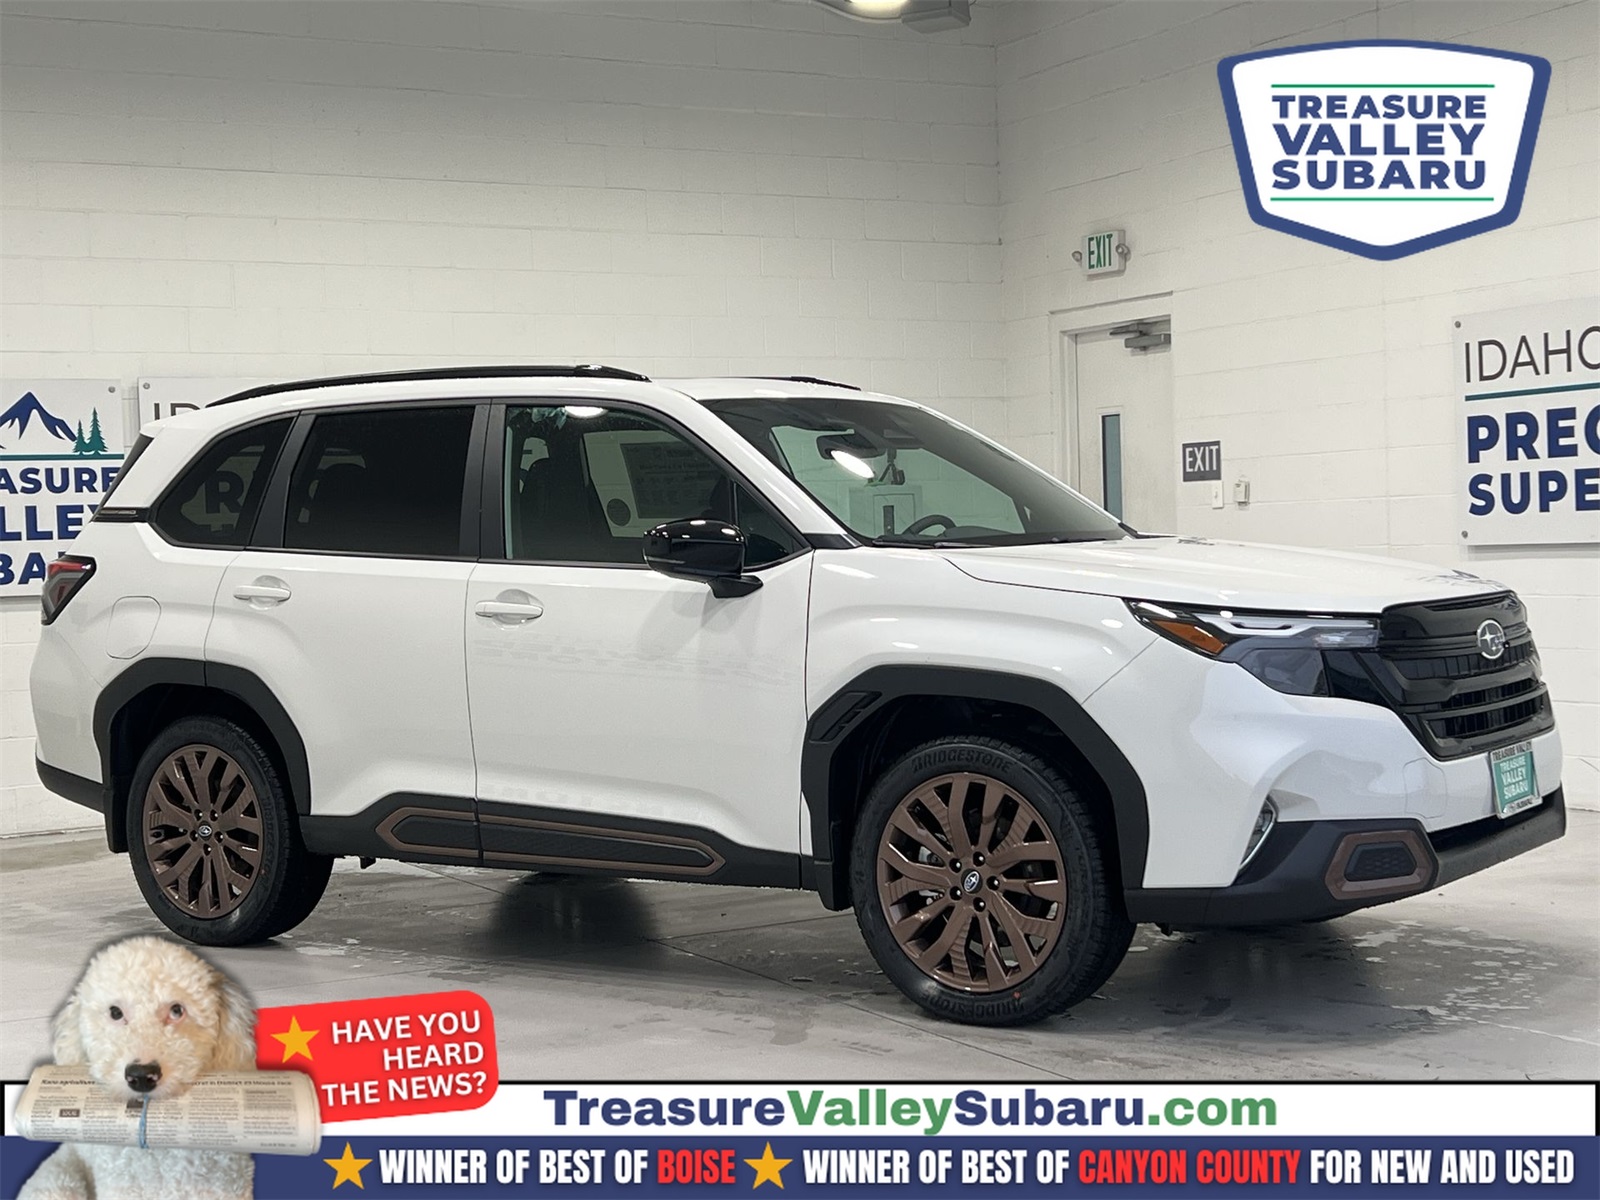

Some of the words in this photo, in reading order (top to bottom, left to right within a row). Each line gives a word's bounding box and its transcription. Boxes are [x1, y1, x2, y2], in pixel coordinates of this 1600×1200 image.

[1088, 233, 1113, 269] EXIT
[1185, 445, 1219, 472] EXIT
[1468, 468, 1600, 516] SUPE
[911, 748, 1015, 773] BRIDGESTONE
[1500, 756, 1526, 772] TREASURE
[1501, 767, 1527, 786] VALLEY
[1503, 780, 1529, 799] SUBARU
